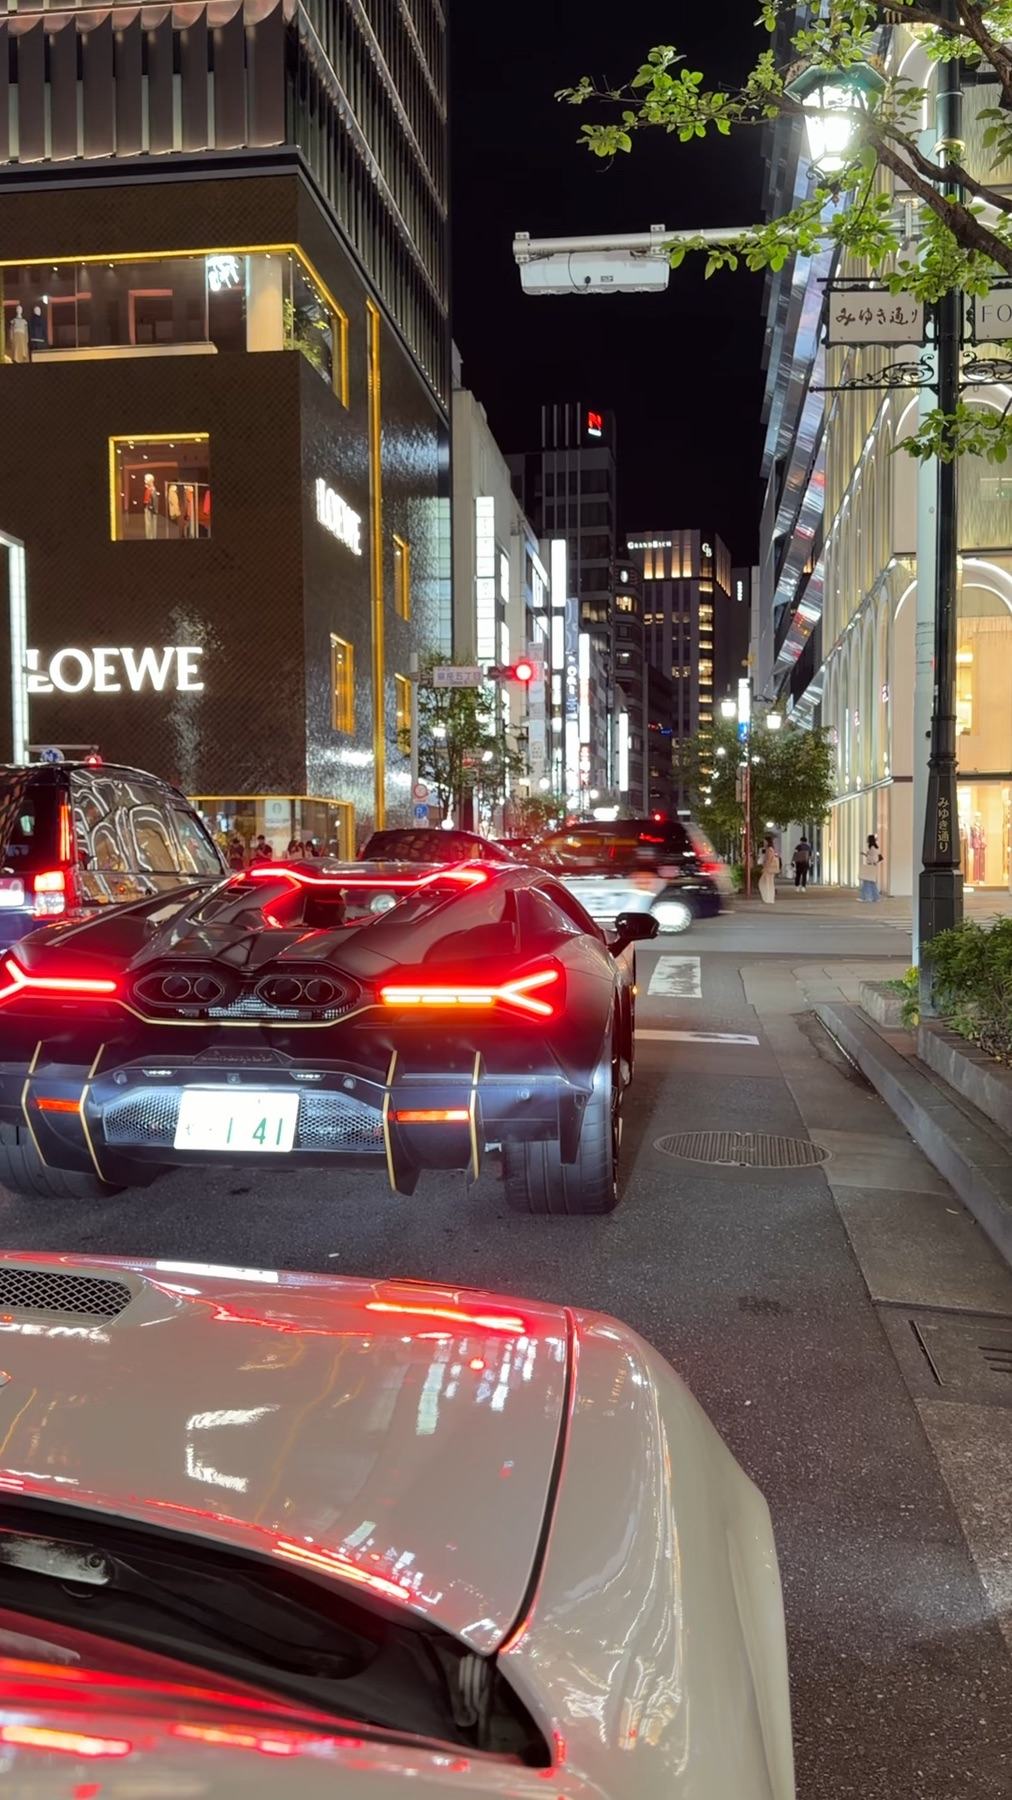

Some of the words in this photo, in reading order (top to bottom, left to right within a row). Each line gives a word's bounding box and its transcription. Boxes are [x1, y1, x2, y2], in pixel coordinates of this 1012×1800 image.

[836, 307, 919, 326] みゆき通り
[25, 646, 205, 693] LOEWE
[937, 797, 950, 853] みゆき通り
